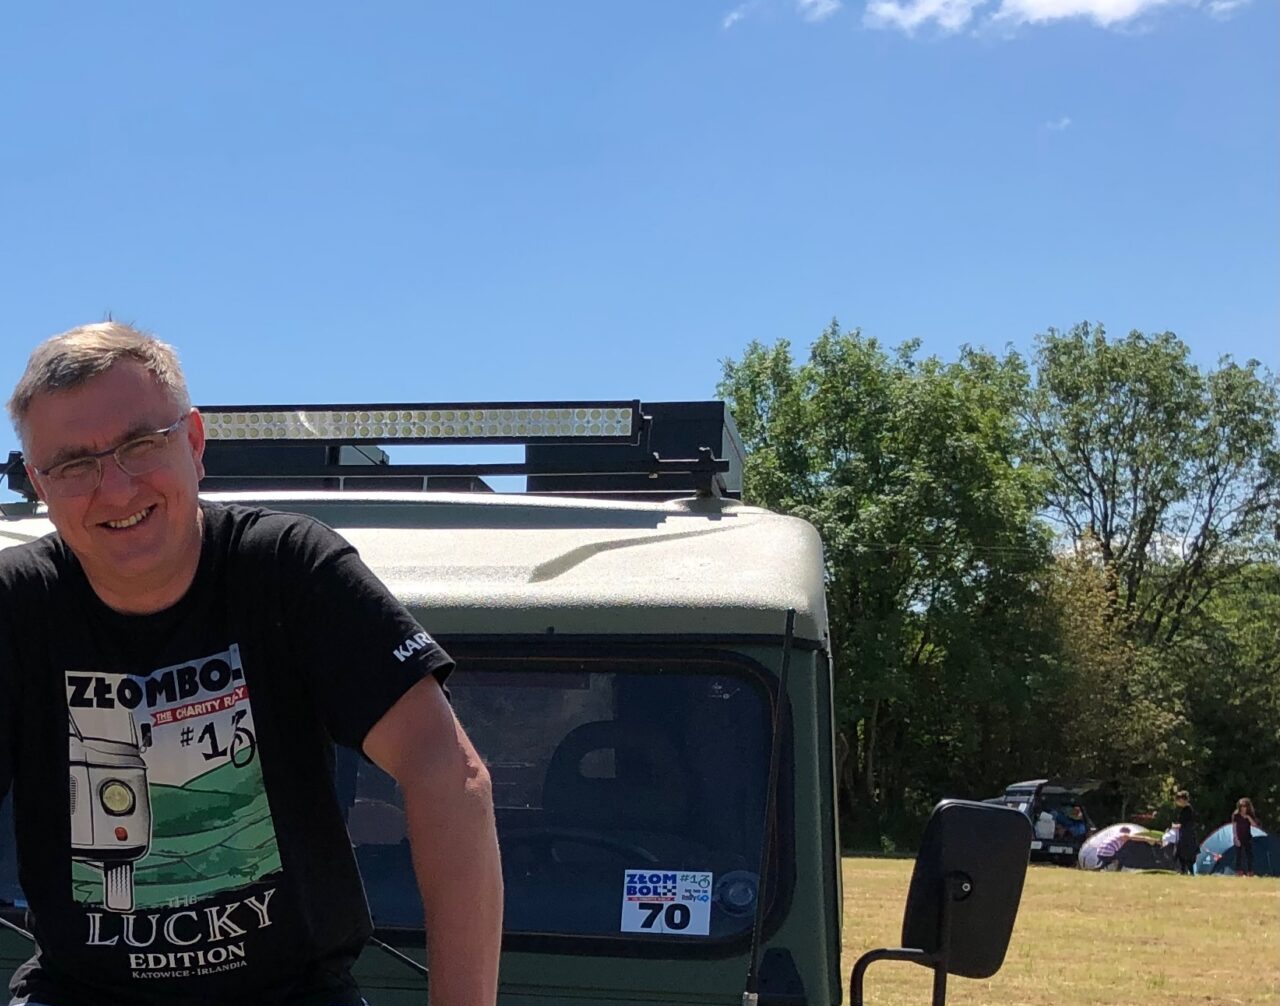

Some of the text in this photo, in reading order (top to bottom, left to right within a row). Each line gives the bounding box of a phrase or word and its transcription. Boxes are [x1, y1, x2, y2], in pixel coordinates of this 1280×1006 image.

[155, 711, 173, 725] THE
[176, 700, 220, 720] CHARITY
[626, 874, 677, 884] ZŁOM
[626, 886, 660, 896] BOL
[86, 889, 276, 947] LUCKY
[639, 903, 691, 930] 70
[129, 942, 246, 968] EDITION
[132, 968, 190, 980] KATOWICE
[197, 960, 248, 977] IRLANDIA
